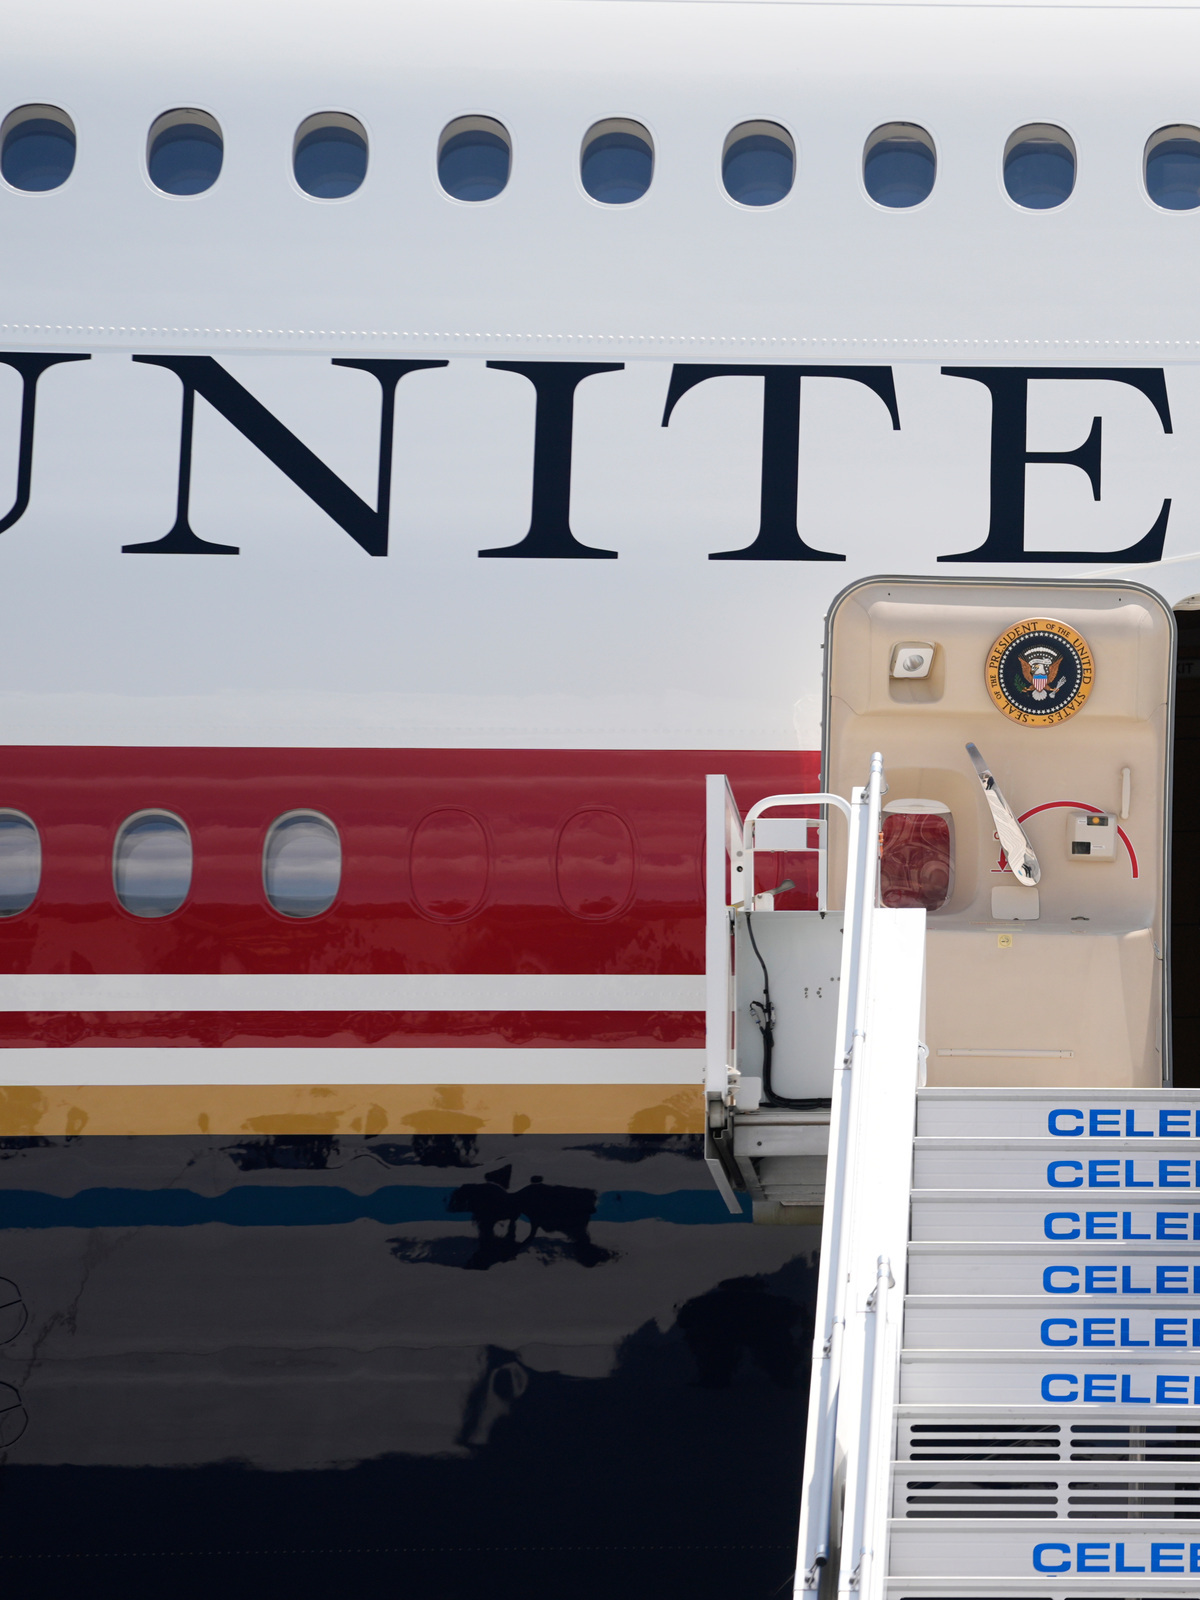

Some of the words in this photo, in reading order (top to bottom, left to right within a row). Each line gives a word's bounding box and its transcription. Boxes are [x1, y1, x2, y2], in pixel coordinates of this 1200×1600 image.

[1046, 623, 1056, 631] OF
[1057, 627, 1071, 638] THE
[989, 621, 1038, 669] PRESIDENT
[1072, 638, 1092, 685] UNITED
[994, 690, 1002, 700] OF
[1002, 700, 1029, 723] SEAL
[1048, 692, 1086, 724] STATES
